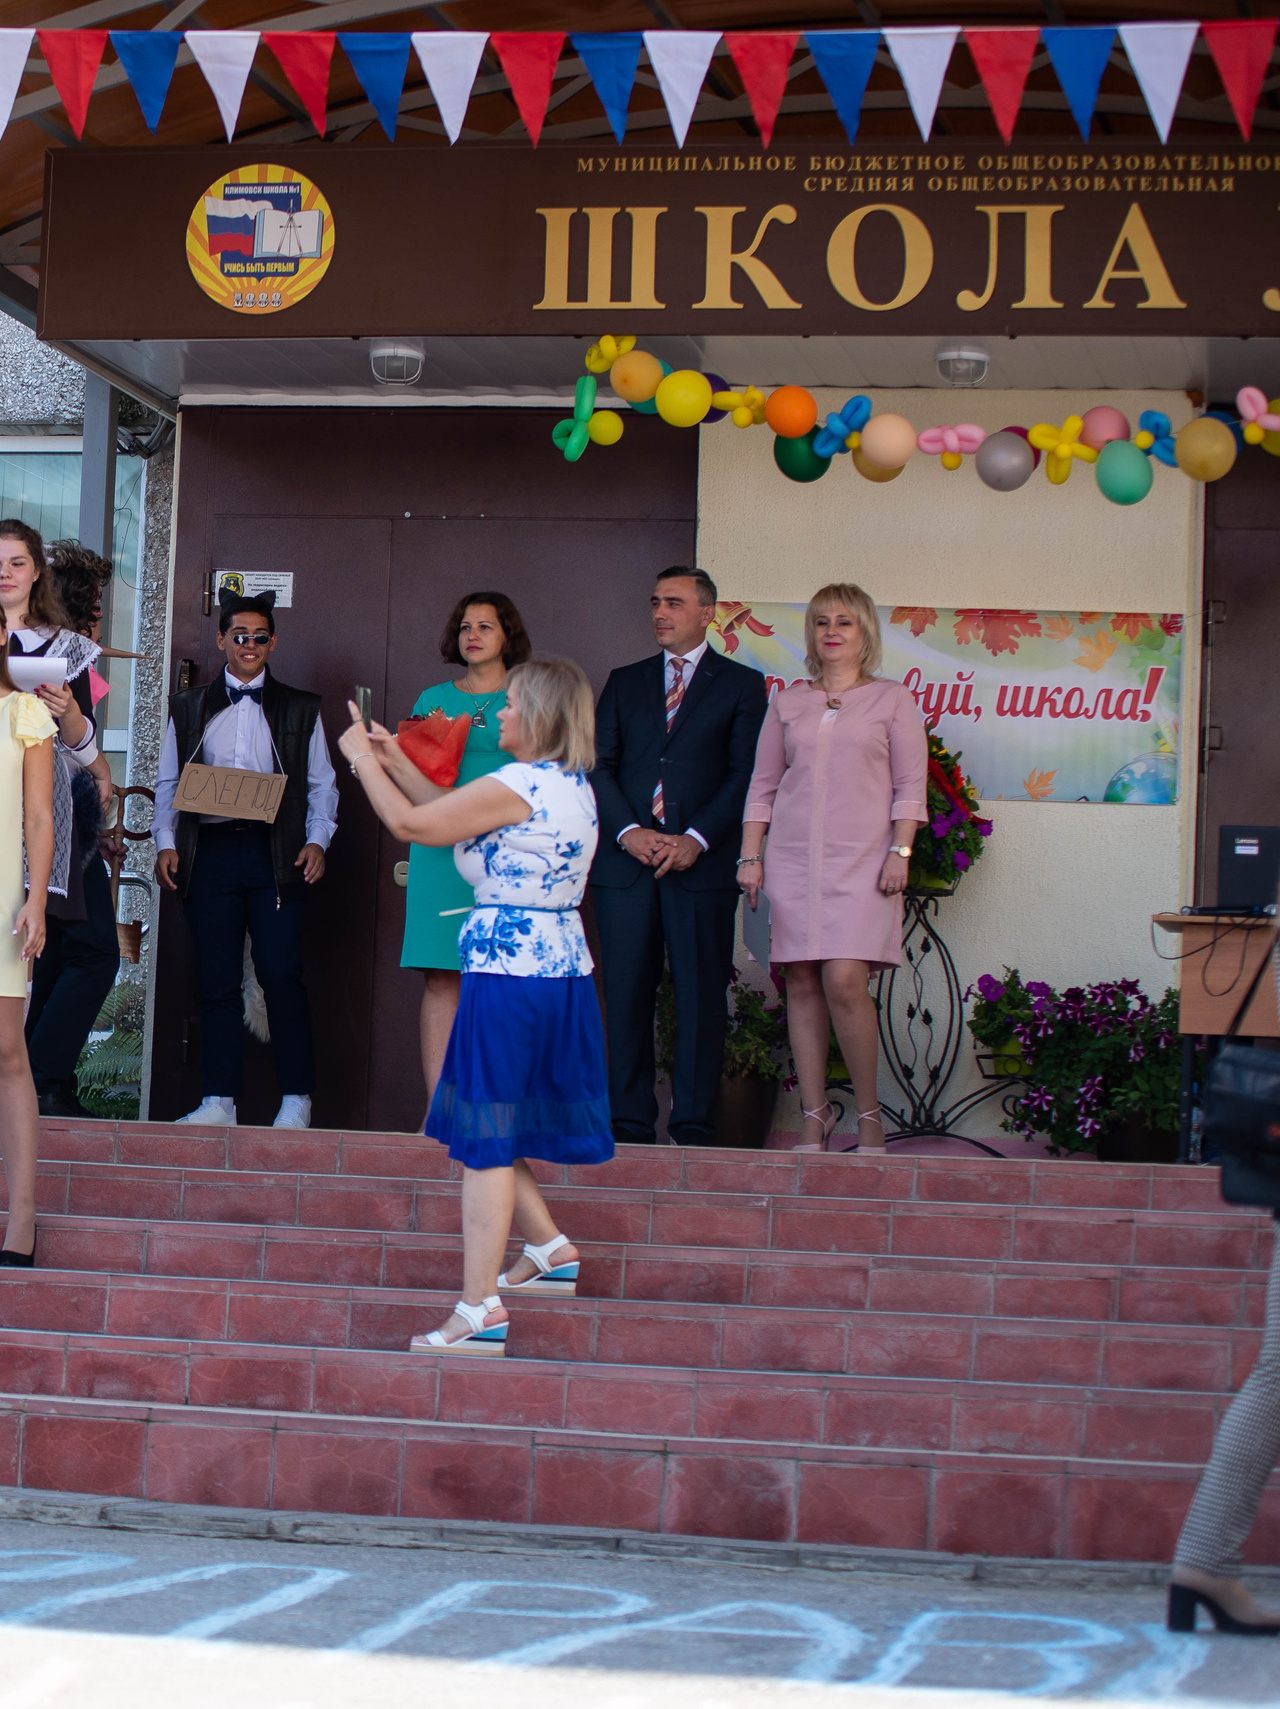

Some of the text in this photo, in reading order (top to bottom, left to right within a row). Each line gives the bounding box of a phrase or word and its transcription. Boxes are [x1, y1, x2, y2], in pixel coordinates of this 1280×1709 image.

[576, 155, 798, 172] МУНИЦИПАЛЬНОЕ
[808, 155, 966, 172] БЮДЖЕТНОЕ
[224, 185, 300, 195] КЛИМОВСК ШКОЛА №1
[803, 175, 1236, 193] СРЕДНЯЯ ОБЩЕОБРАЗОВАТЕЛЬНАЯ
[532, 202, 1188, 312] ШКОЛА
[224, 262, 295, 274] УЧИСЬ БЫТЬ ПЕРВЫМ
[995, 666, 1169, 723] школа!
[182, 769, 284, 813] СЛЕПОЙ
